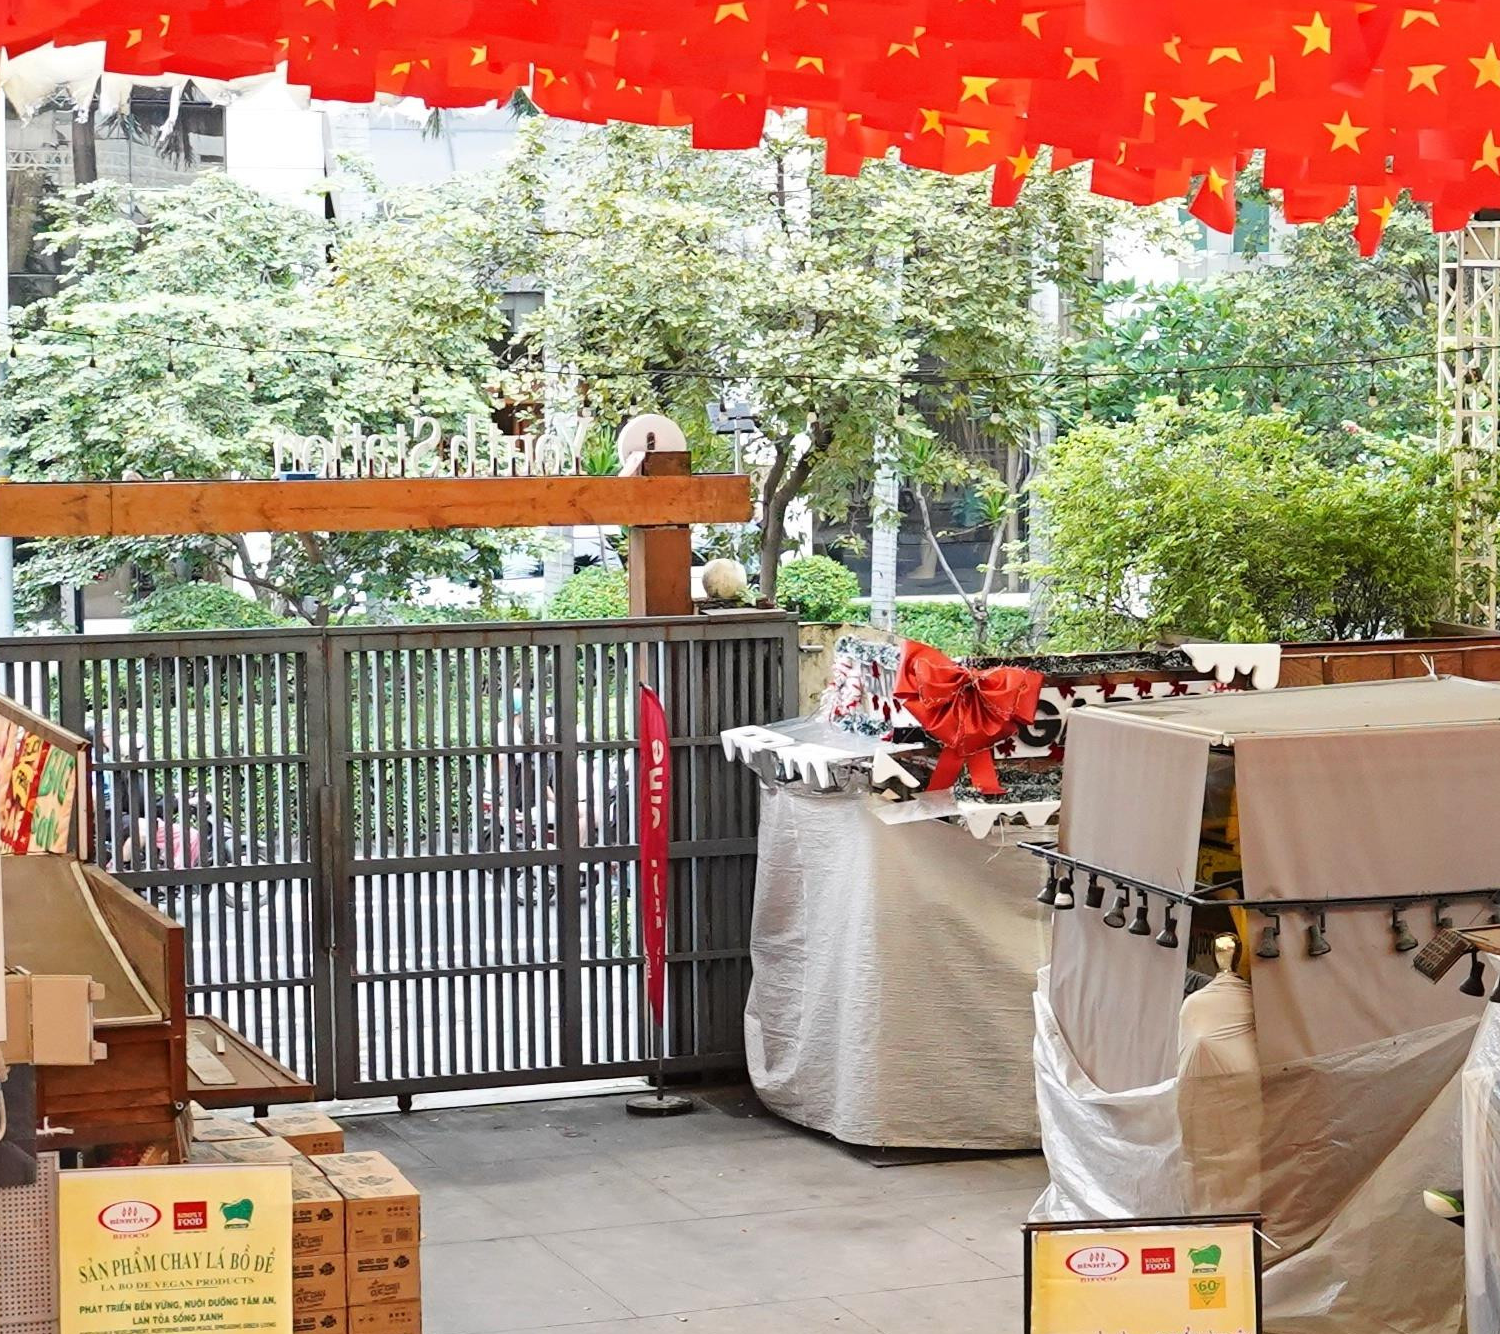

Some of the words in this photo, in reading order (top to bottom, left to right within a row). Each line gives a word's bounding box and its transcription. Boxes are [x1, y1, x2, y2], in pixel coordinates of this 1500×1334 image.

[177, 1218, 204, 1227] FOOD
[160, 1251, 202, 1272] CHAY
[206, 1248, 225, 1270] LÁ
[1145, 1262, 1171, 1271] FOOD
[1198, 1279, 1217, 1292] 60
